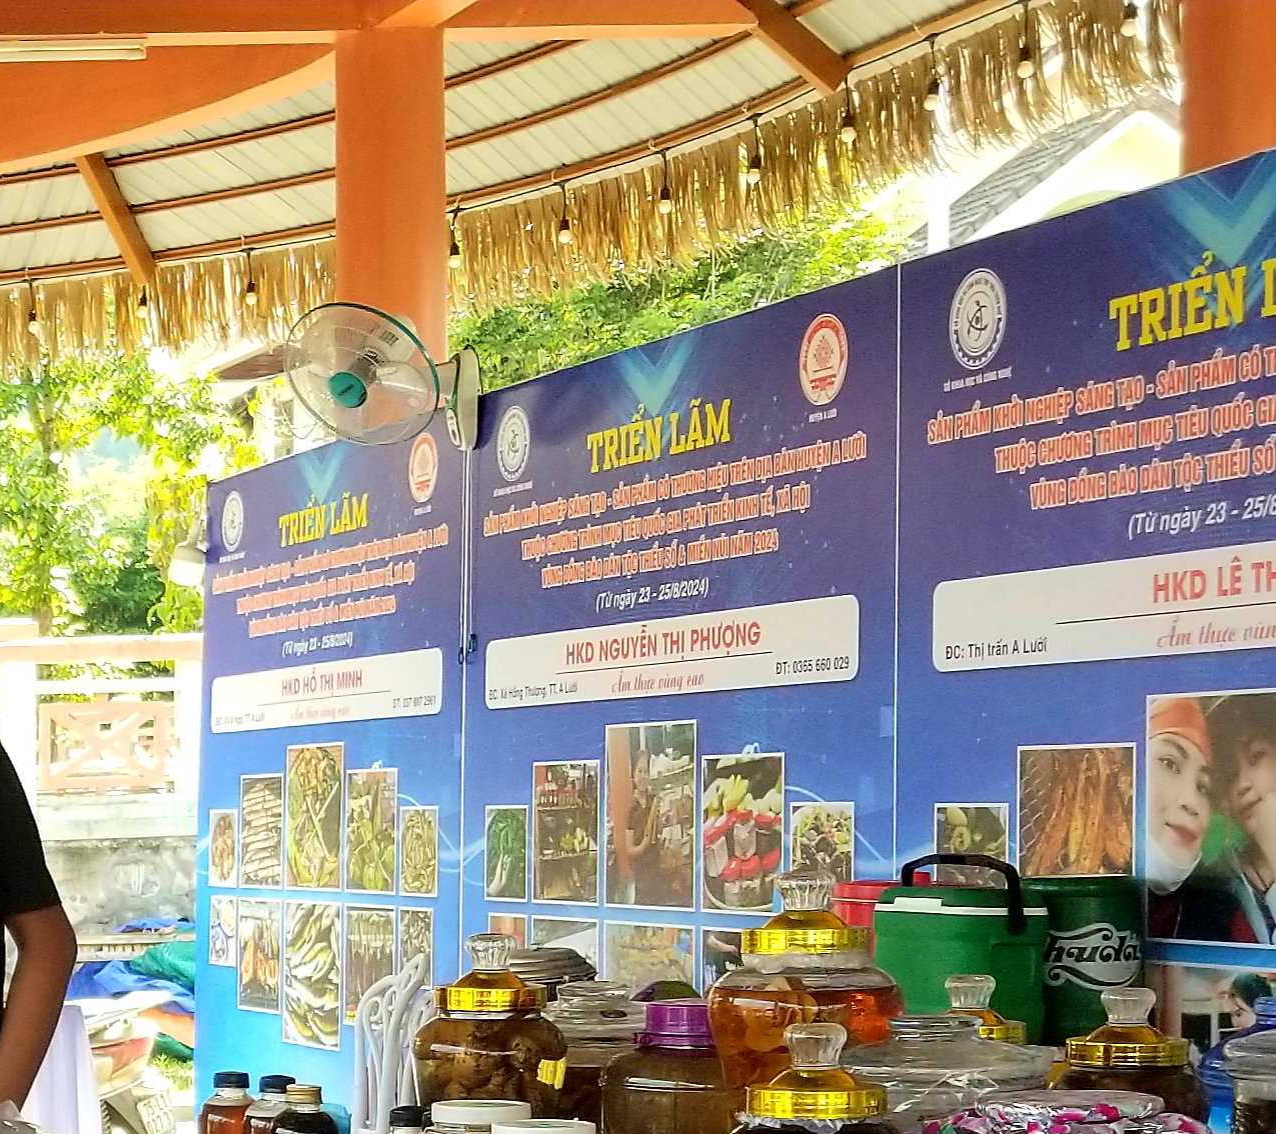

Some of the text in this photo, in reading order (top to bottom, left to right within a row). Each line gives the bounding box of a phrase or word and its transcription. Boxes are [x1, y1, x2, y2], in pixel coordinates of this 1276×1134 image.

[1109, 250, 1247, 351] TRIỂN
[954, 400, 991, 440] PHẨM
[1025, 387, 1073, 424] NGHIỆP
[1075, 380, 1113, 416] SÁNG
[1117, 375, 1144, 411] TẠO
[1155, 360, 1188, 399] SẢN
[1191, 347, 1236, 392] PHẨM
[1239, 344, 1261, 381] CÓ
[587, 398, 731, 474] TRIỂN LÃM
[831, 442, 841, 465] A
[994, 392, 1254, 474] THUỘC CHƯƠNG TRÌNH MỤC TIÊU QUỐC
[1030, 433, 1276, 510] VÙNG ĐỒNG BÀO DÂN TỘC THIỂU SỐ
[279, 491, 369, 547] TRIỂN LÃM
[735, 494, 759, 522] KINH
[792, 481, 811, 514] HỘI
[1128, 513, 1155, 541] (Từ
[1159, 509, 1200, 535] ngày
[1205, 501, 1228, 525] 23
[754, 527, 779, 554] 2024
[613, 588, 637, 611] ngày
[638, 586, 651, 603] 23
[658, 576, 710, 602] 25/8/2024)
[1153, 555, 1242, 603] HKD LÊ
[566, 620, 761, 666] HKD NGUYỄN THỊ PHƯỢNG
[945, 636, 1048, 662] ĐC: Thị trấn A Lưới
[281, 669, 363, 698] HKD THỊ MINH
[775, 661, 791, 675] ĐT:
[833, 656, 850, 670] 029
